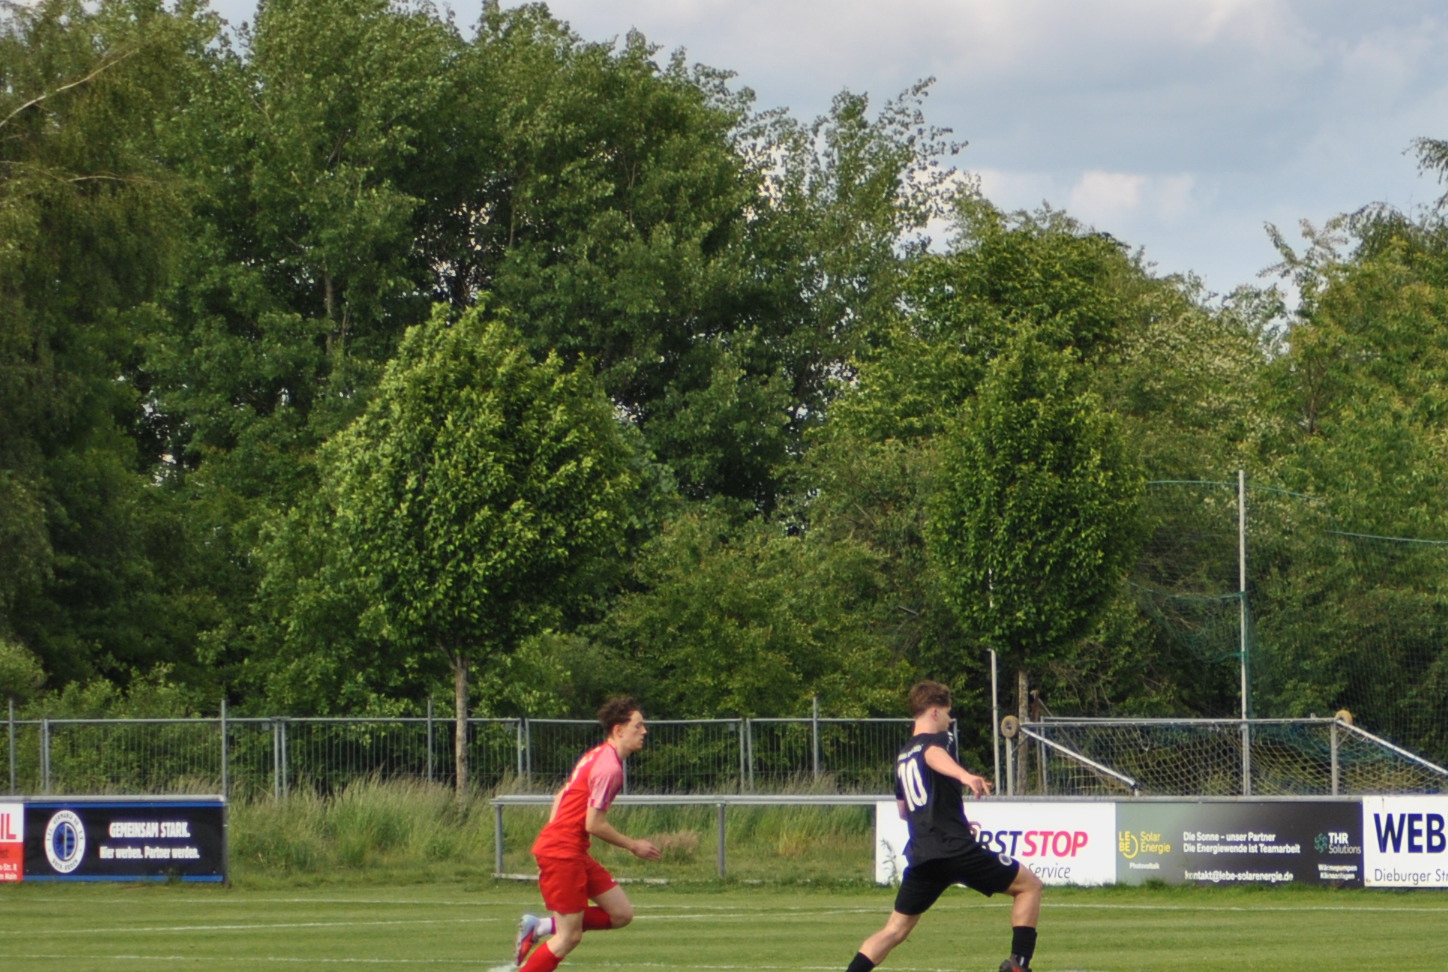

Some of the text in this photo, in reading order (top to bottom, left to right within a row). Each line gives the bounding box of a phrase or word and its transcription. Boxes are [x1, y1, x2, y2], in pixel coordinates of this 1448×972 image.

[898, 758, 928, 812] 10
[109, 822, 191, 838] GEMEINSAM STARK.
[1140, 831, 1161, 841] Solar
[1183, 831, 1195, 841] Die
[1196, 831, 1219, 841] Sonne
[1226, 833, 1246, 841] unser
[1247, 831, 1276, 842] Partner
[1328, 832, 1349, 844] THR
[1140, 843, 1171, 855] Energie
[1183, 843, 1301, 855] Die Energiewende ist Teamarbeit
[1328, 844, 1362, 855] Solutions
[1184, 870, 1294, 883] kontakt@lebe-solarenergie.de
[1374, 868, 1431, 885] Dieburger
